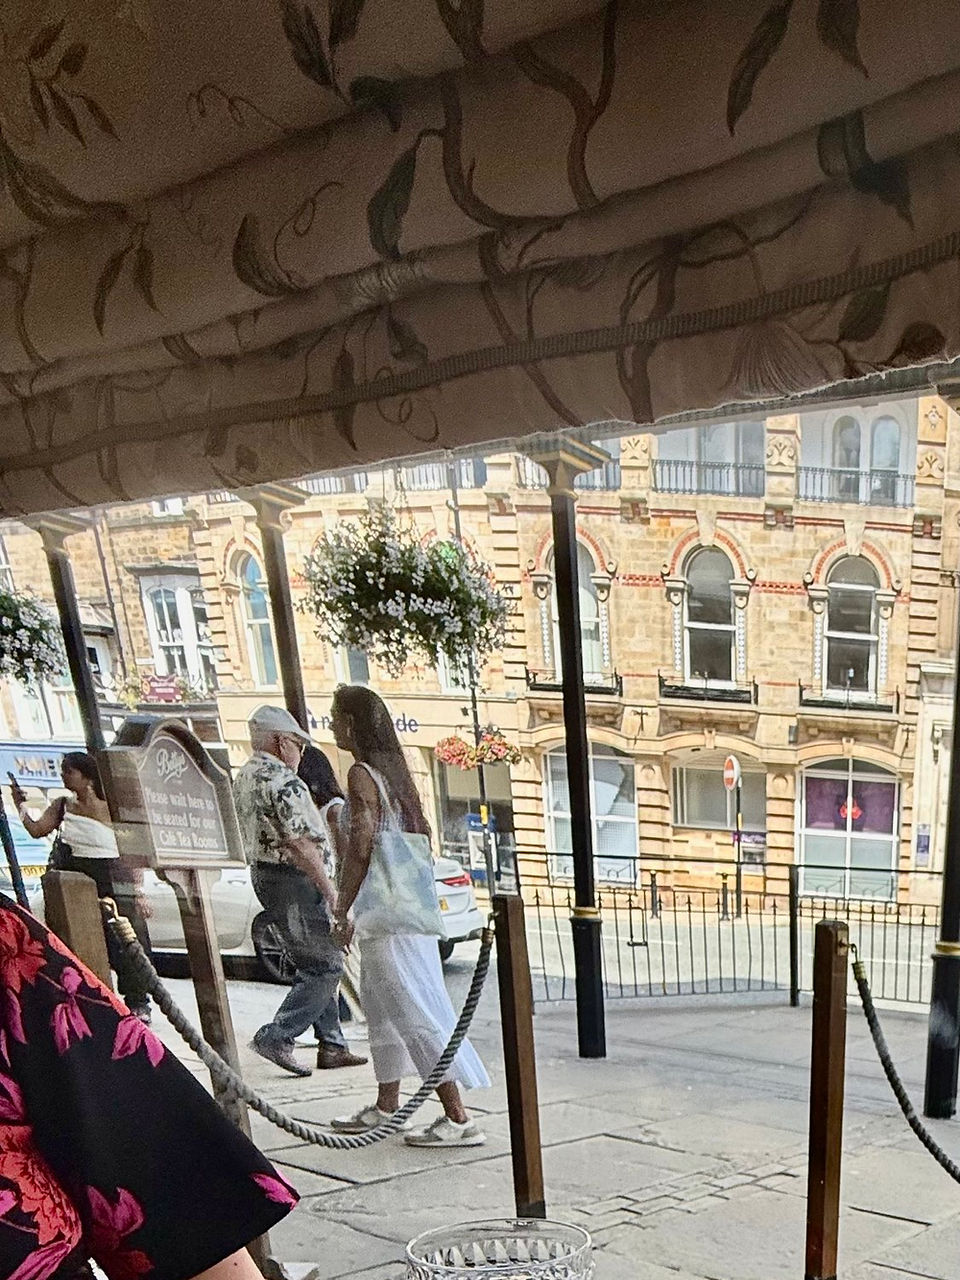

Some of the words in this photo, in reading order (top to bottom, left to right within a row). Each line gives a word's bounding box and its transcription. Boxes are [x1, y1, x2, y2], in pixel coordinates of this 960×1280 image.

[157, 749, 185, 777] Bettys
[170, 793, 187, 807] wait
[187, 793, 204, 809] here
[204, 799, 215, 811] to
[152, 809, 162, 824] be
[163, 812, 188, 826] seated
[189, 812, 200, 828] for
